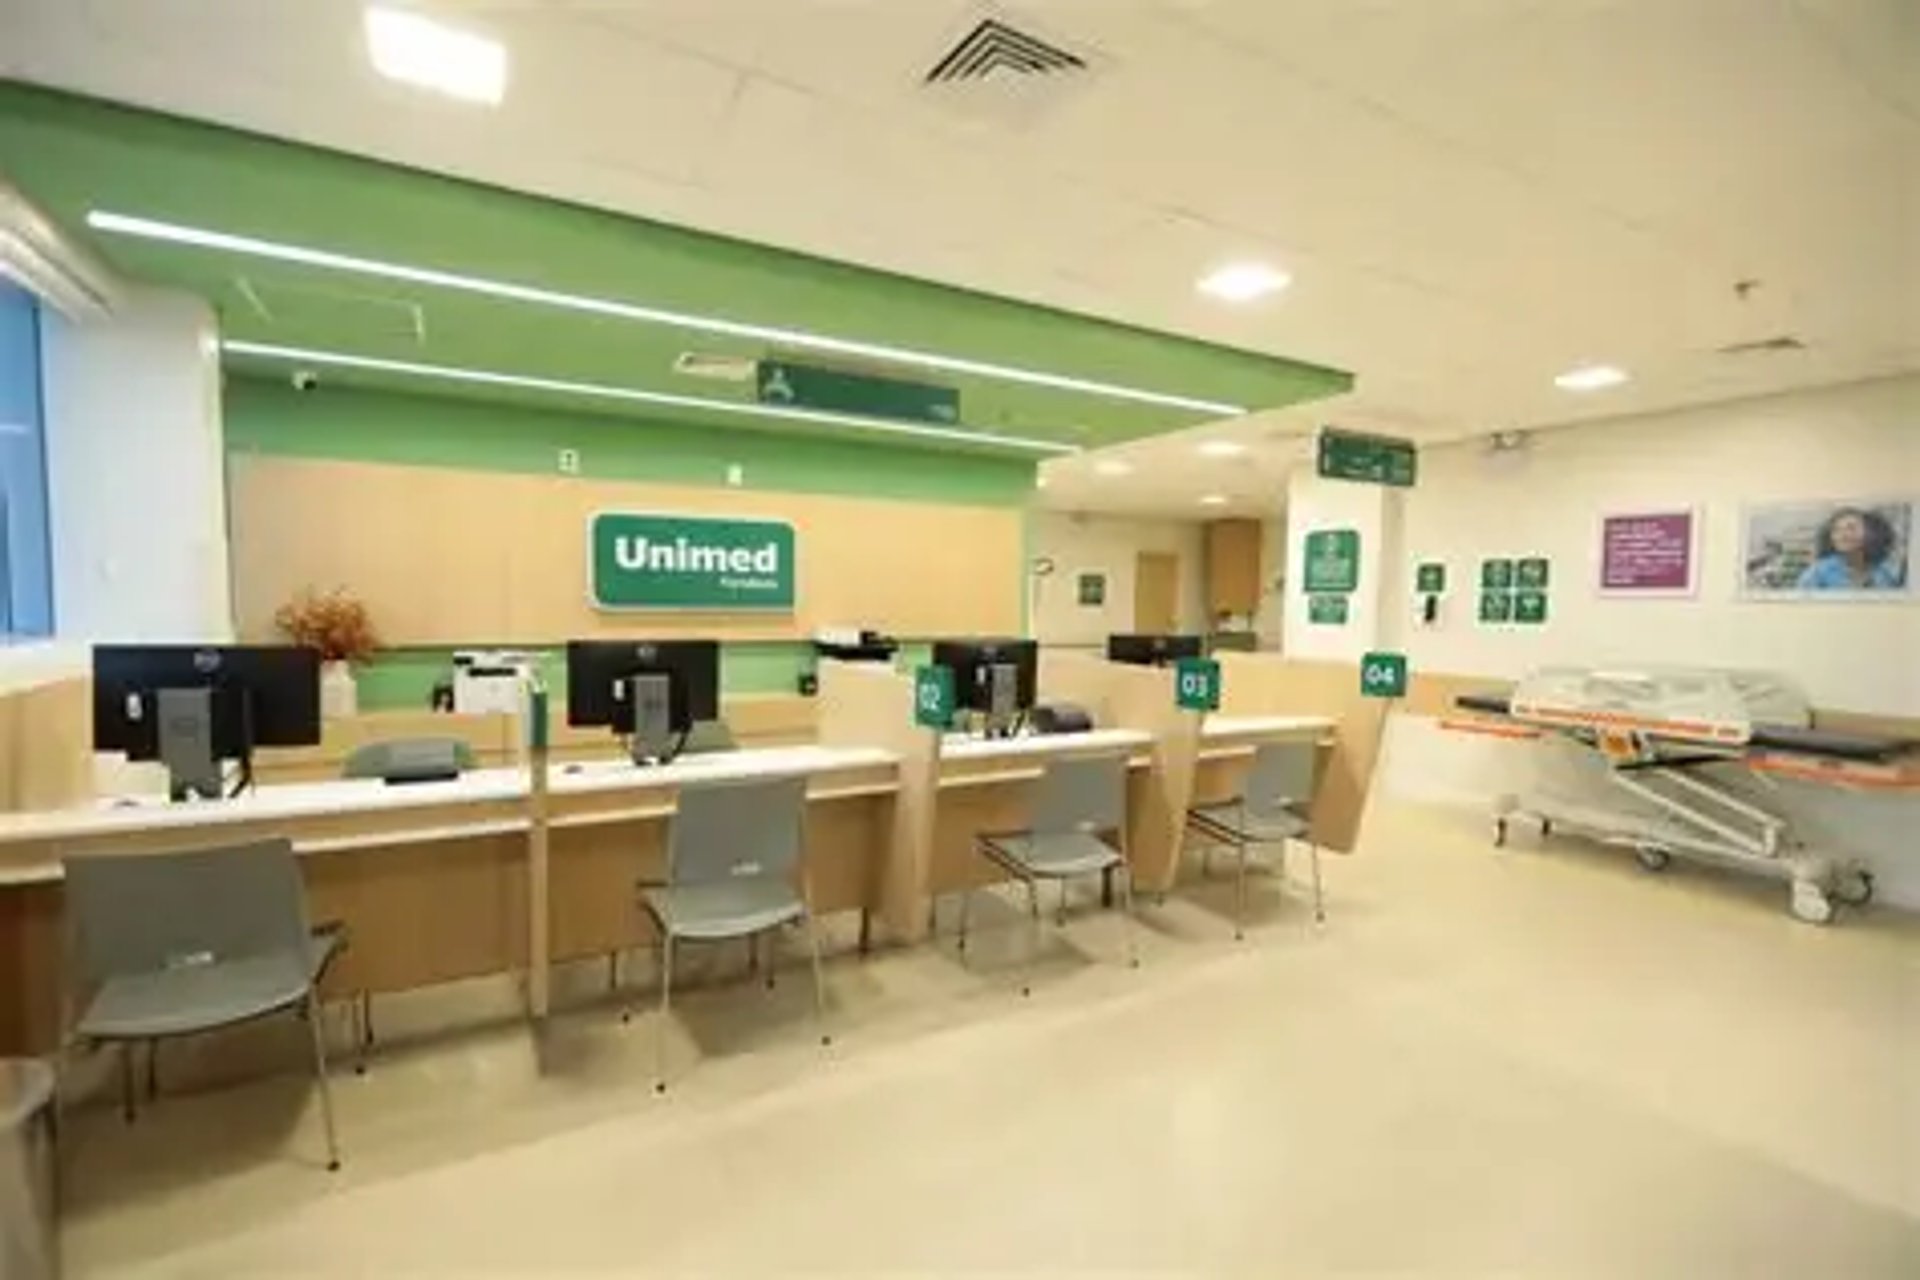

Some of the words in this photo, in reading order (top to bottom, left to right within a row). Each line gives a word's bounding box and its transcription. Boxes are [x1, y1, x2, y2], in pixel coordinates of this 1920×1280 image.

[614, 536, 778, 573] Unimed
[1182, 672, 1208, 697] 03
[1365, 663, 1394, 685] 04
[919, 683, 940, 713] 02
